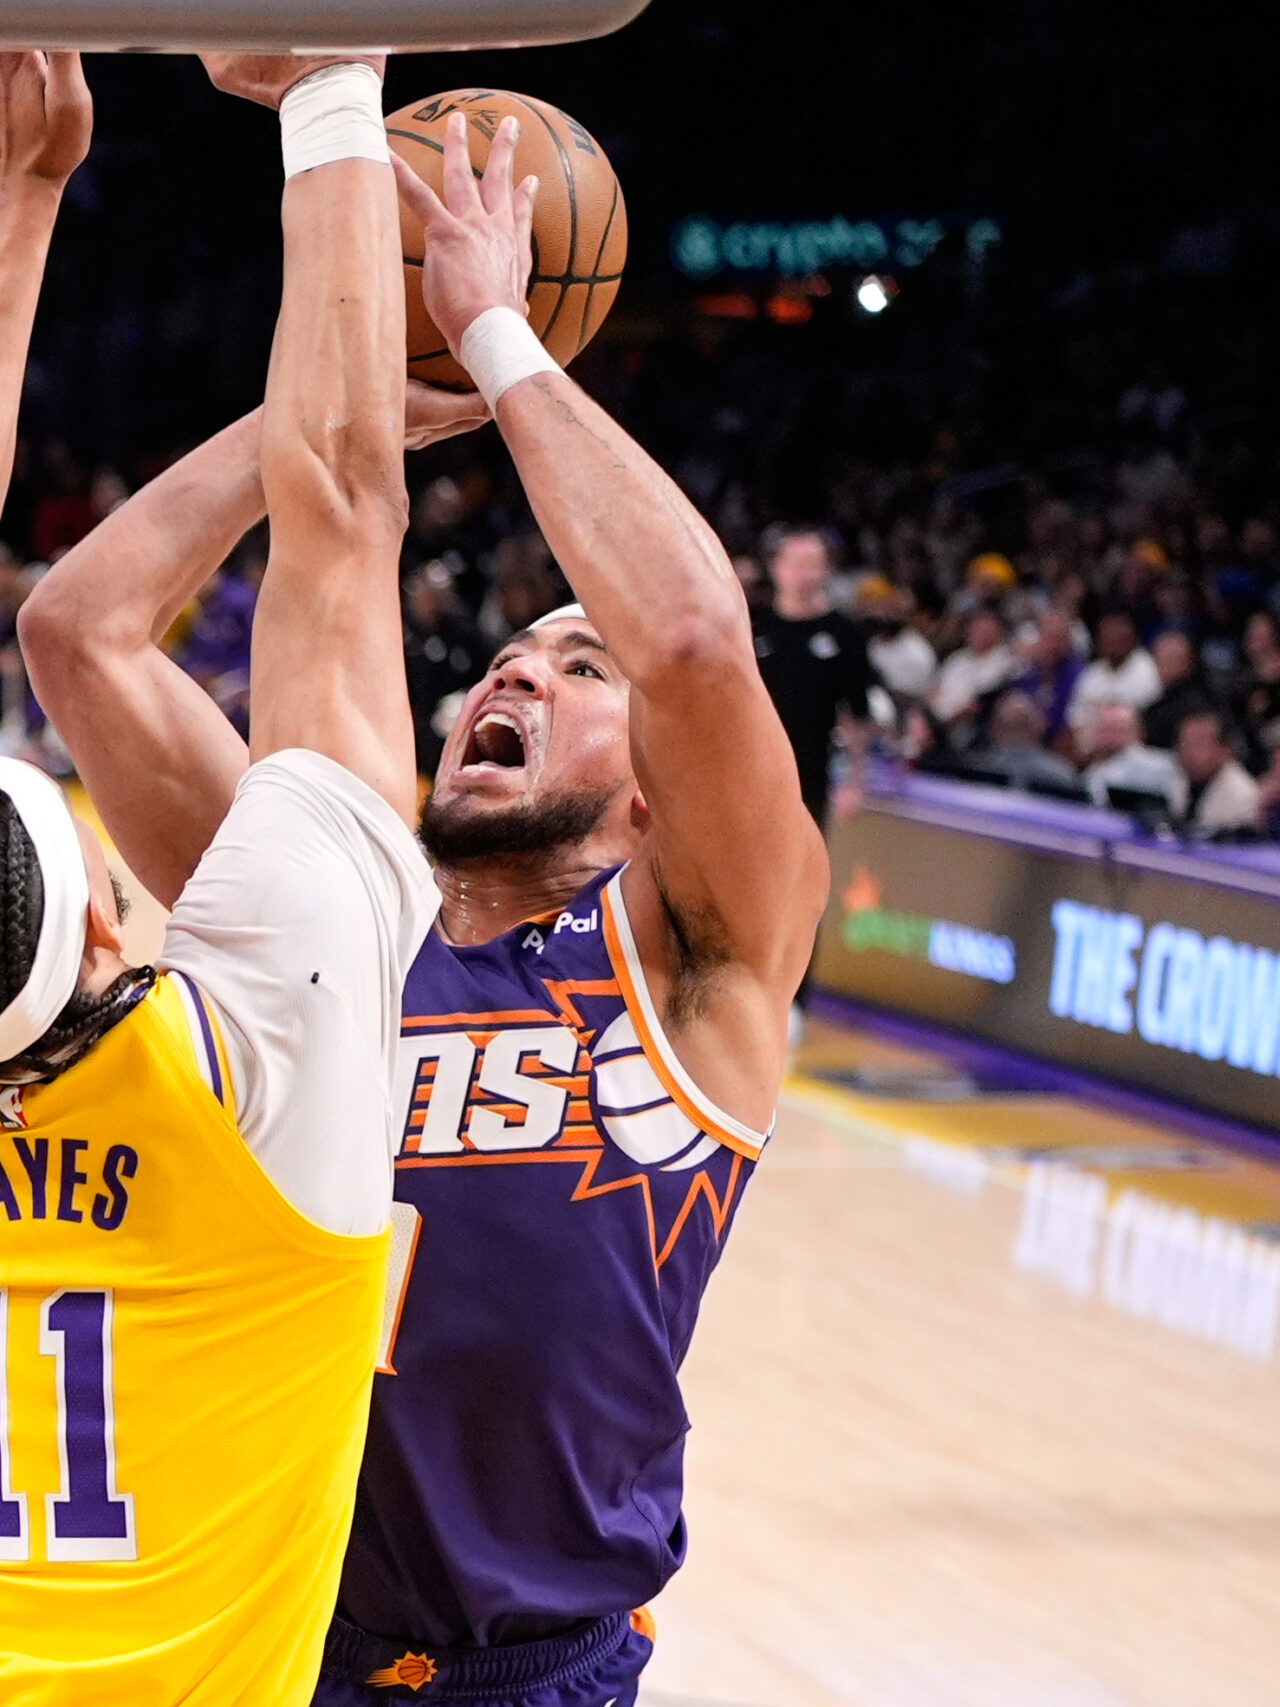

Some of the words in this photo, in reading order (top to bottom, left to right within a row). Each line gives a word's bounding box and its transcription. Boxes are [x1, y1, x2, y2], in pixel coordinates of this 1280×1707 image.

[521, 908, 598, 955] PPal
[1049, 899, 1144, 1034] THE
[394, 1026, 580, 1156] NS
